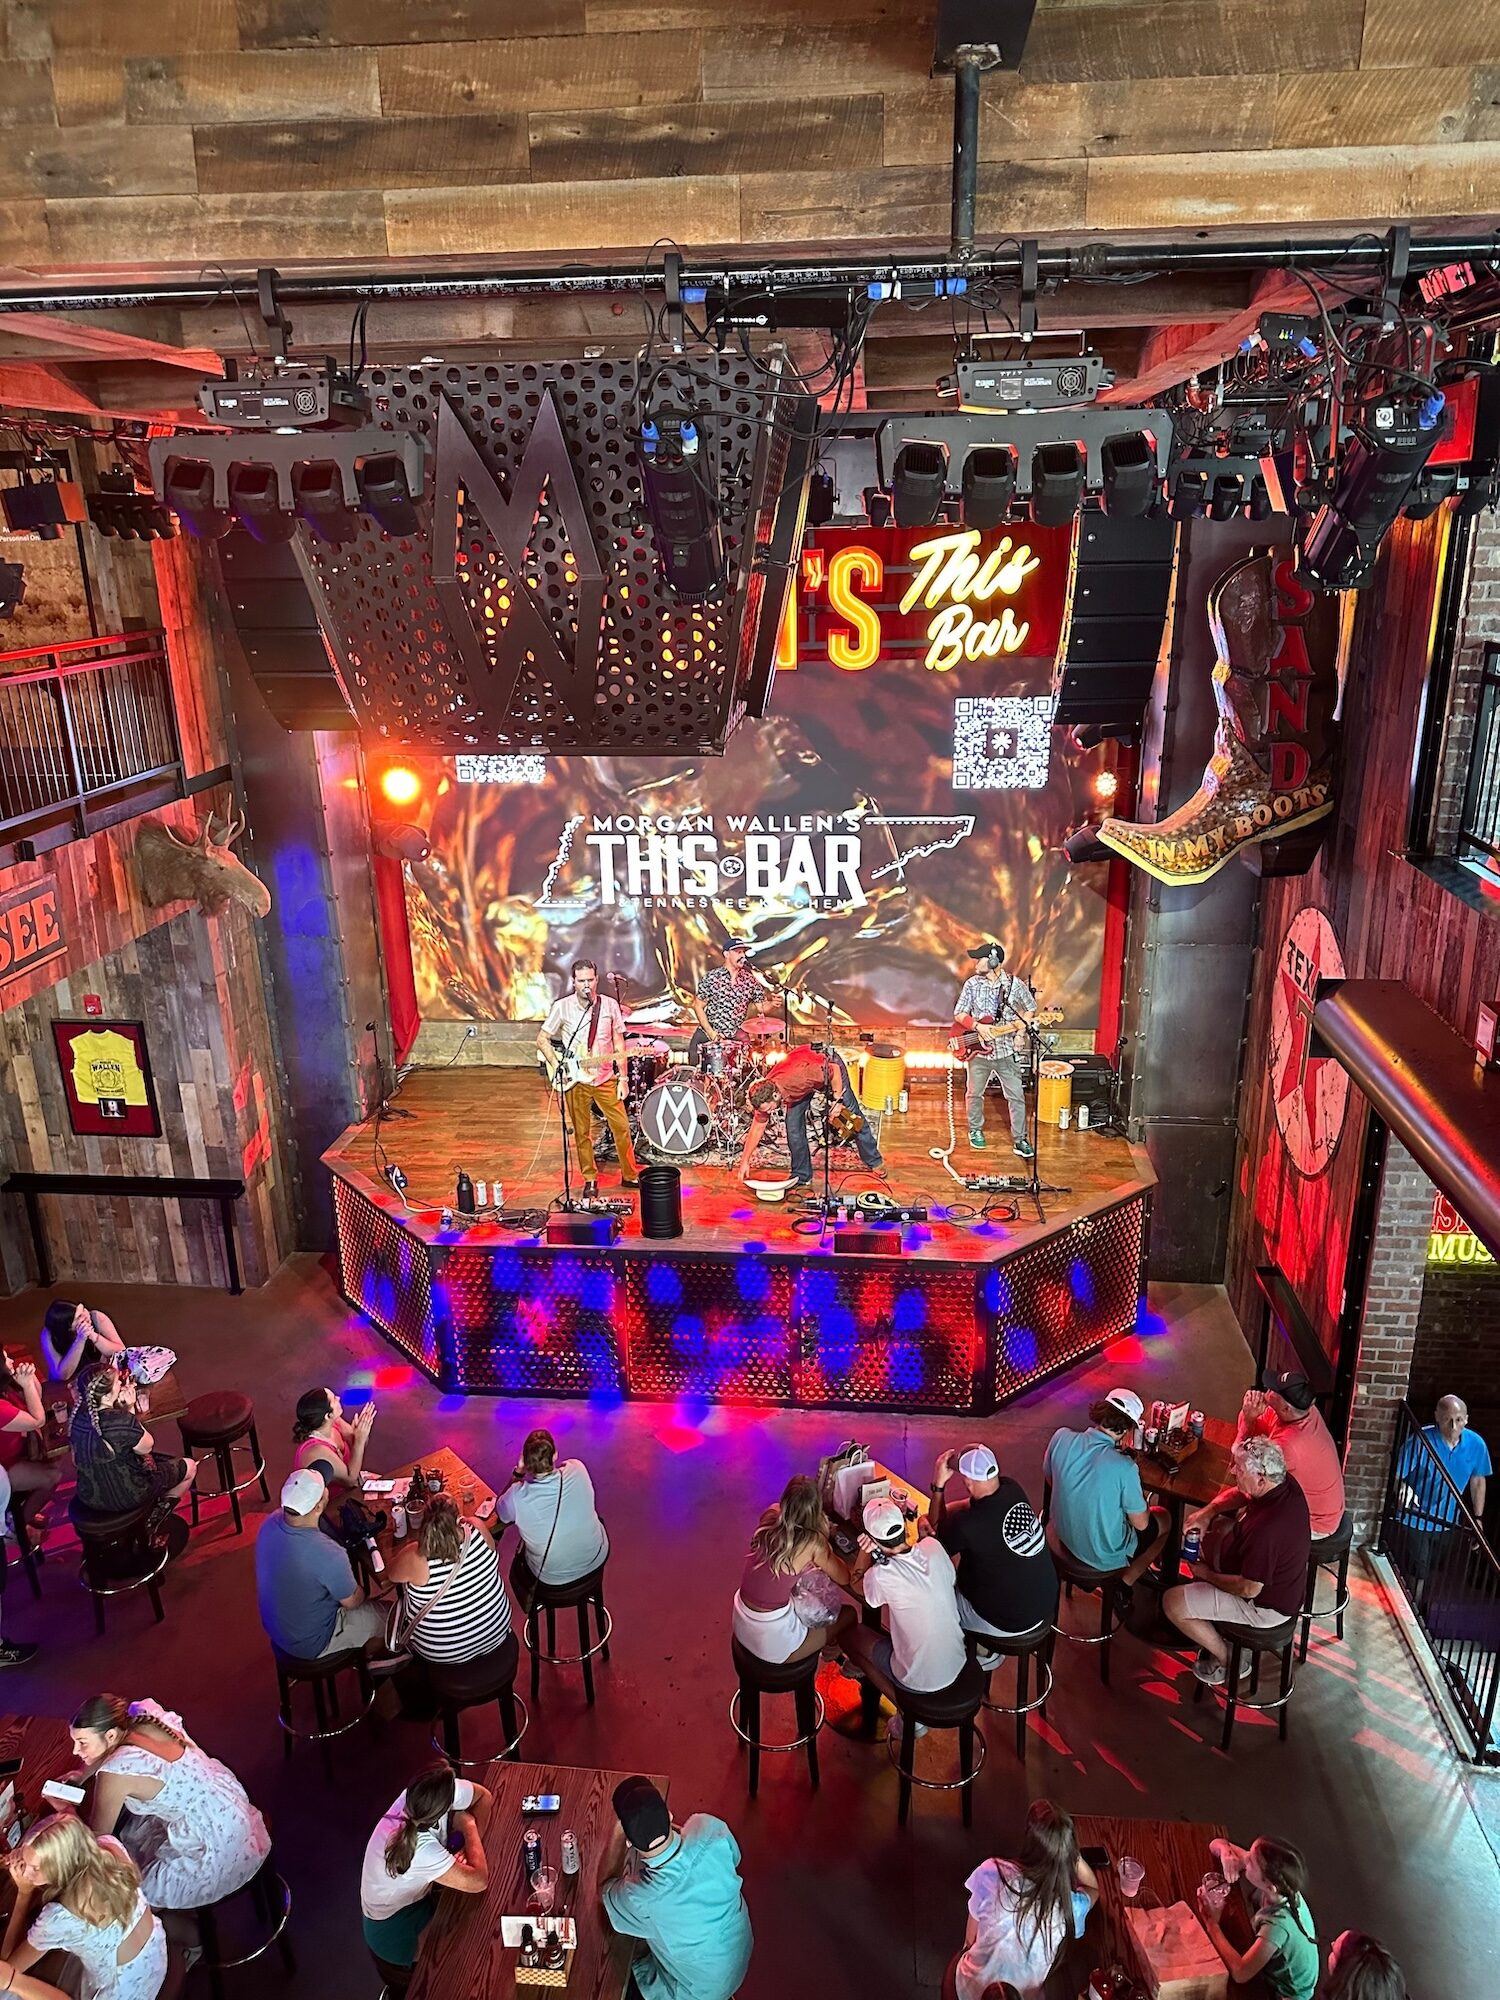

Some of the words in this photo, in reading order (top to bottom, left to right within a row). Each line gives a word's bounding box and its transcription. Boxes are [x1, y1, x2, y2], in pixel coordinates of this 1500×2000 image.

[776, 545, 884, 671] 'S
[899, 529, 1041, 616] This
[923, 603, 1030, 672] Bar
[1266, 559, 1316, 792] SAND
[592, 815, 714, 832] MORGAN
[726, 815, 862, 832] WALLEN'S
[1149, 837, 1177, 863] IN
[1184, 826, 1226, 859] MY
[1234, 784, 1329, 838] BOOTS
[585, 834, 718, 905] THIS
[745, 834, 869, 906] BAR
[761, 897, 849, 909] KTCHEN
